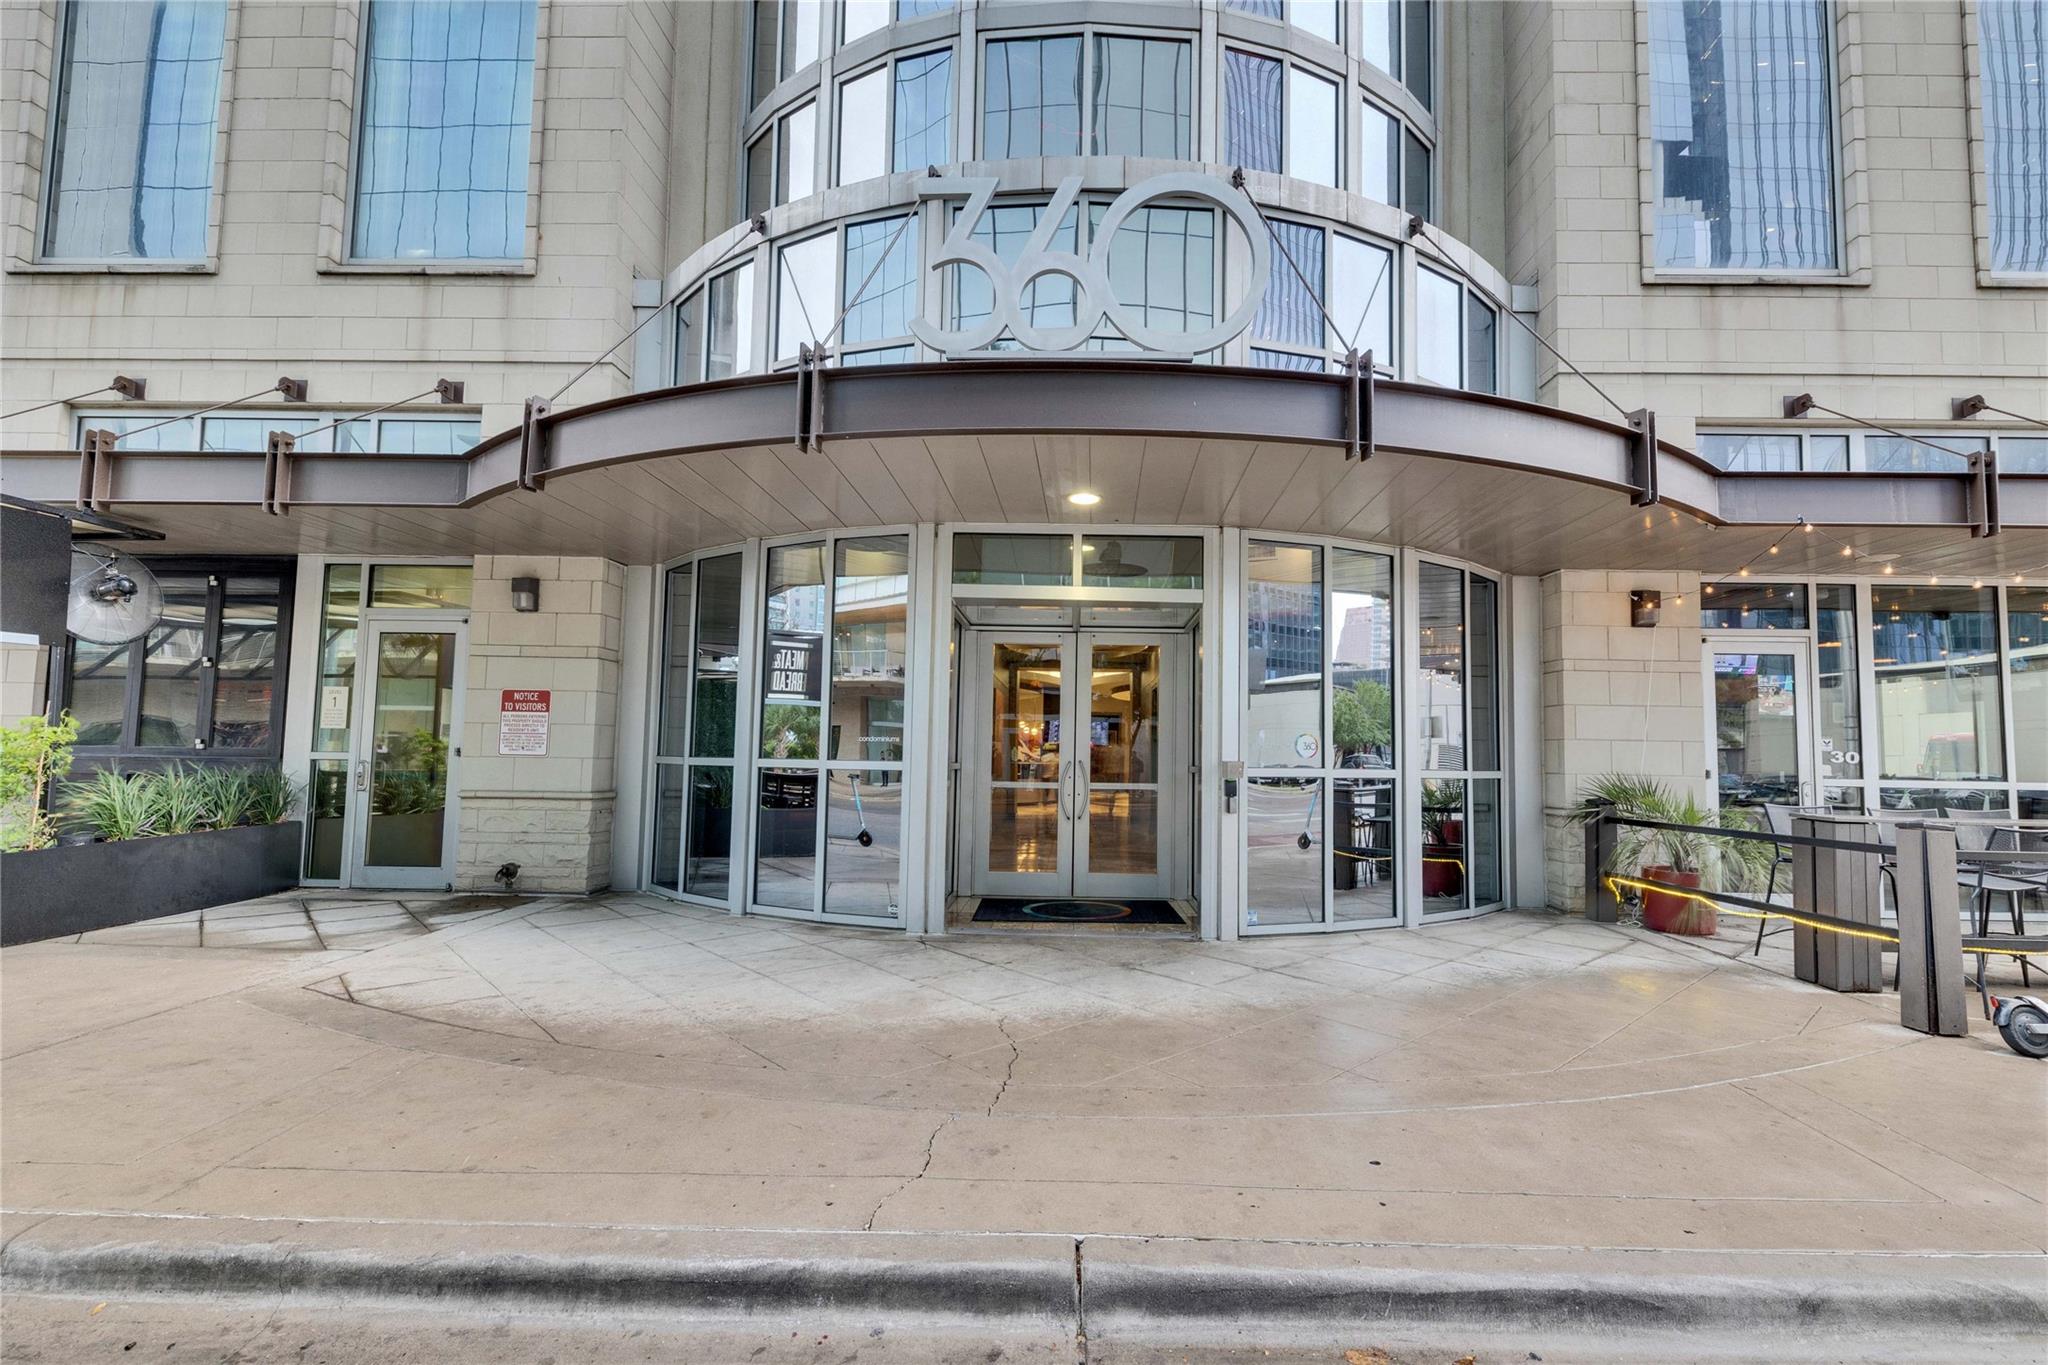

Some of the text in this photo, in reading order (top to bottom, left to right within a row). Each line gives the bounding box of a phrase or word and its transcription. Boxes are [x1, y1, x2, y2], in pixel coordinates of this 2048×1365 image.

[908, 171, 1271, 354] 360
[514, 692, 539, 700] NOTICE
[504, 702, 547, 711] TO VISITORS
[1830, 750, 1860, 764] 30
